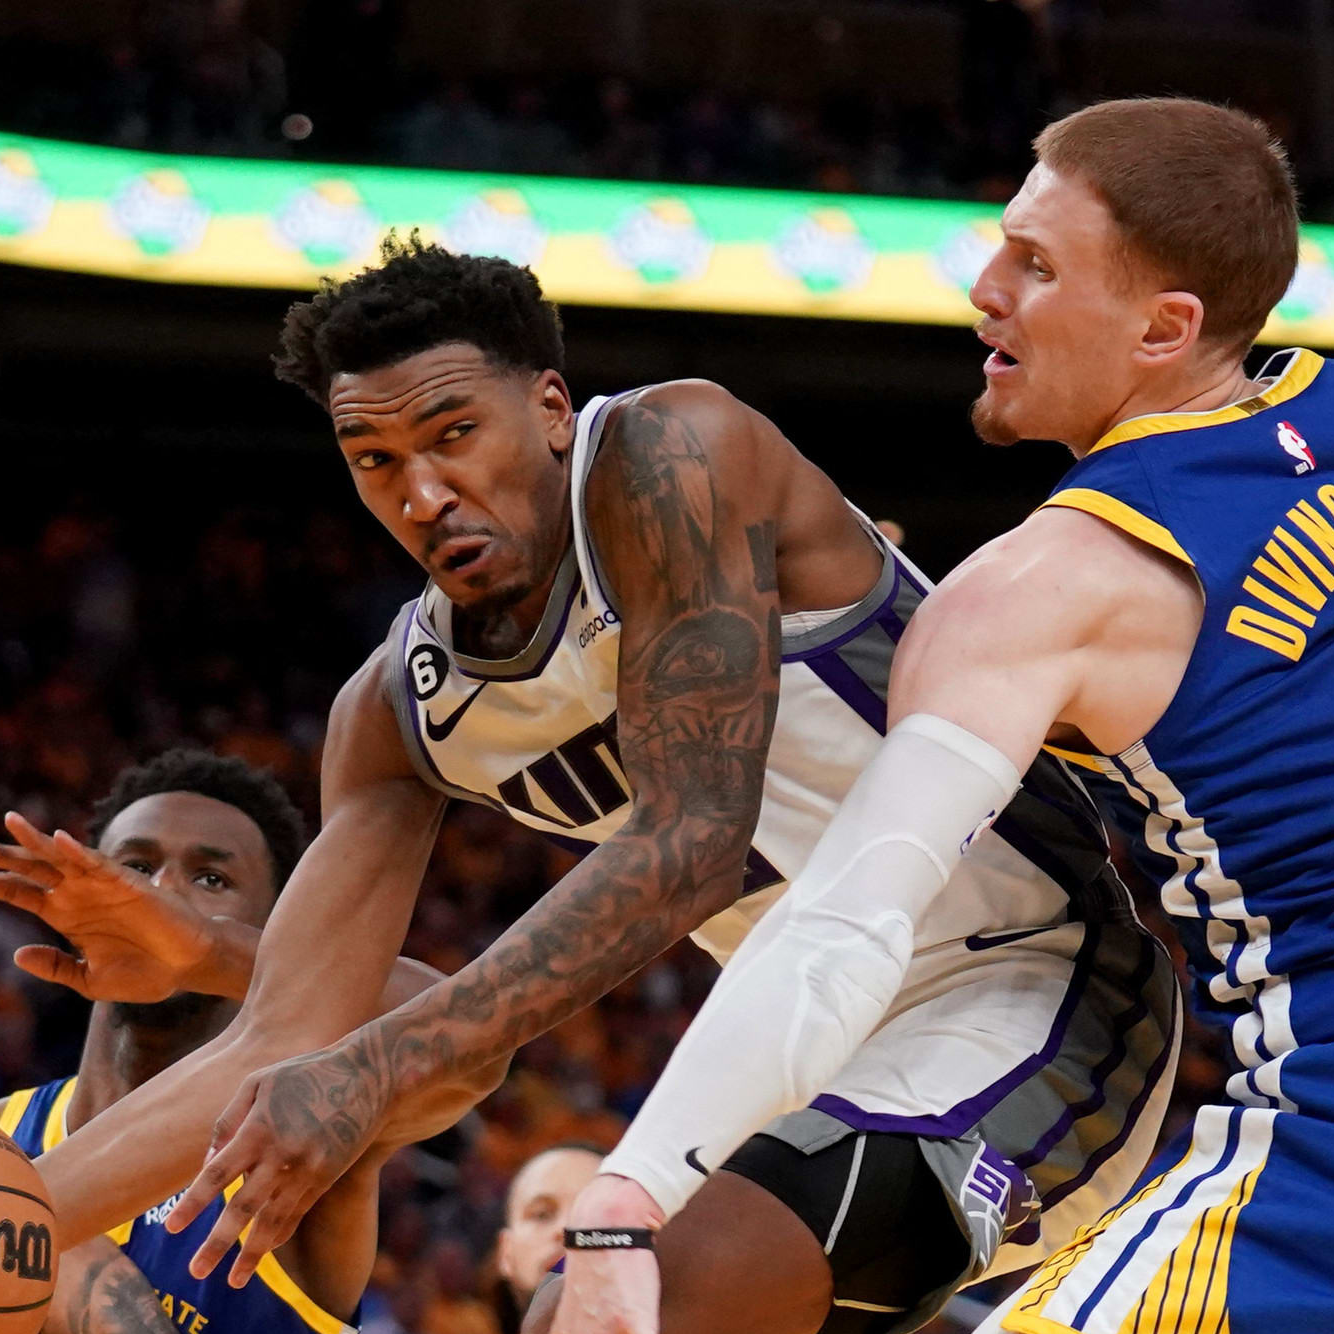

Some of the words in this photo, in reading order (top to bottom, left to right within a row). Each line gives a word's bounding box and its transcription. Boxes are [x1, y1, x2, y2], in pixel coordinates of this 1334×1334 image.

[410, 650, 439, 696] 6
[497, 708, 631, 830] KIN
[574, 1230, 634, 1248] Believe
